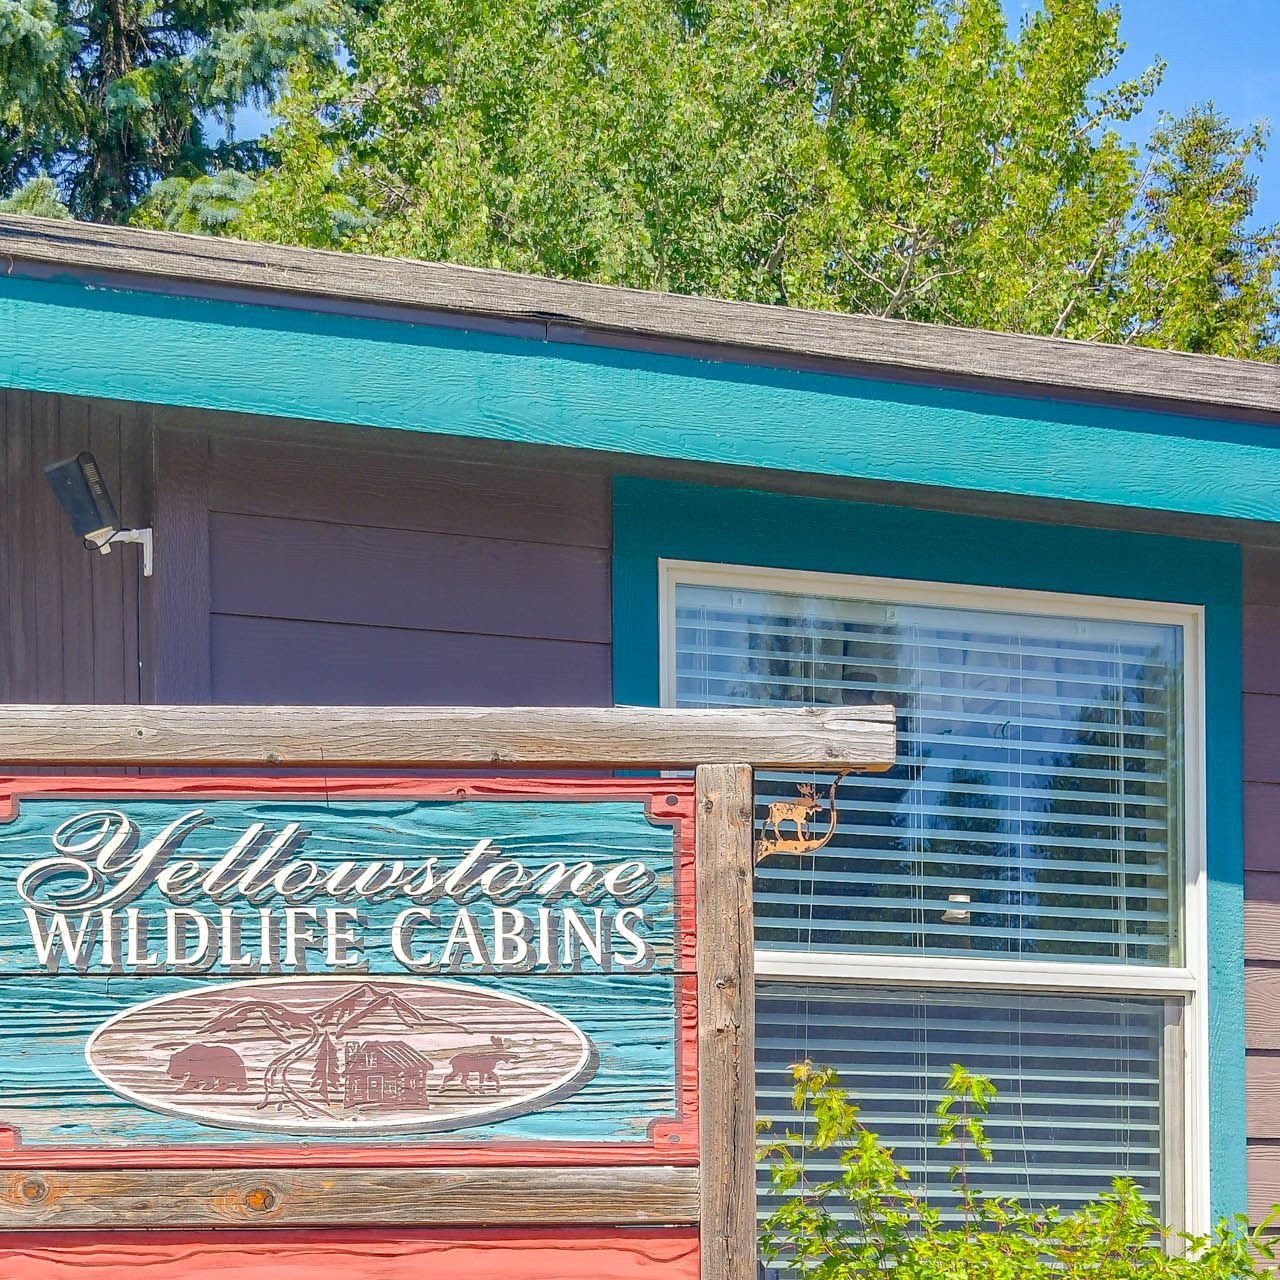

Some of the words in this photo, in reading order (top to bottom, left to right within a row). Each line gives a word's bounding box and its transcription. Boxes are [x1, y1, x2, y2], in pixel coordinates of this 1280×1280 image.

[16, 808, 653, 912] Yellowstone
[22, 906, 360, 967] WILDLIFE
[391, 905, 650, 967] CABINS
